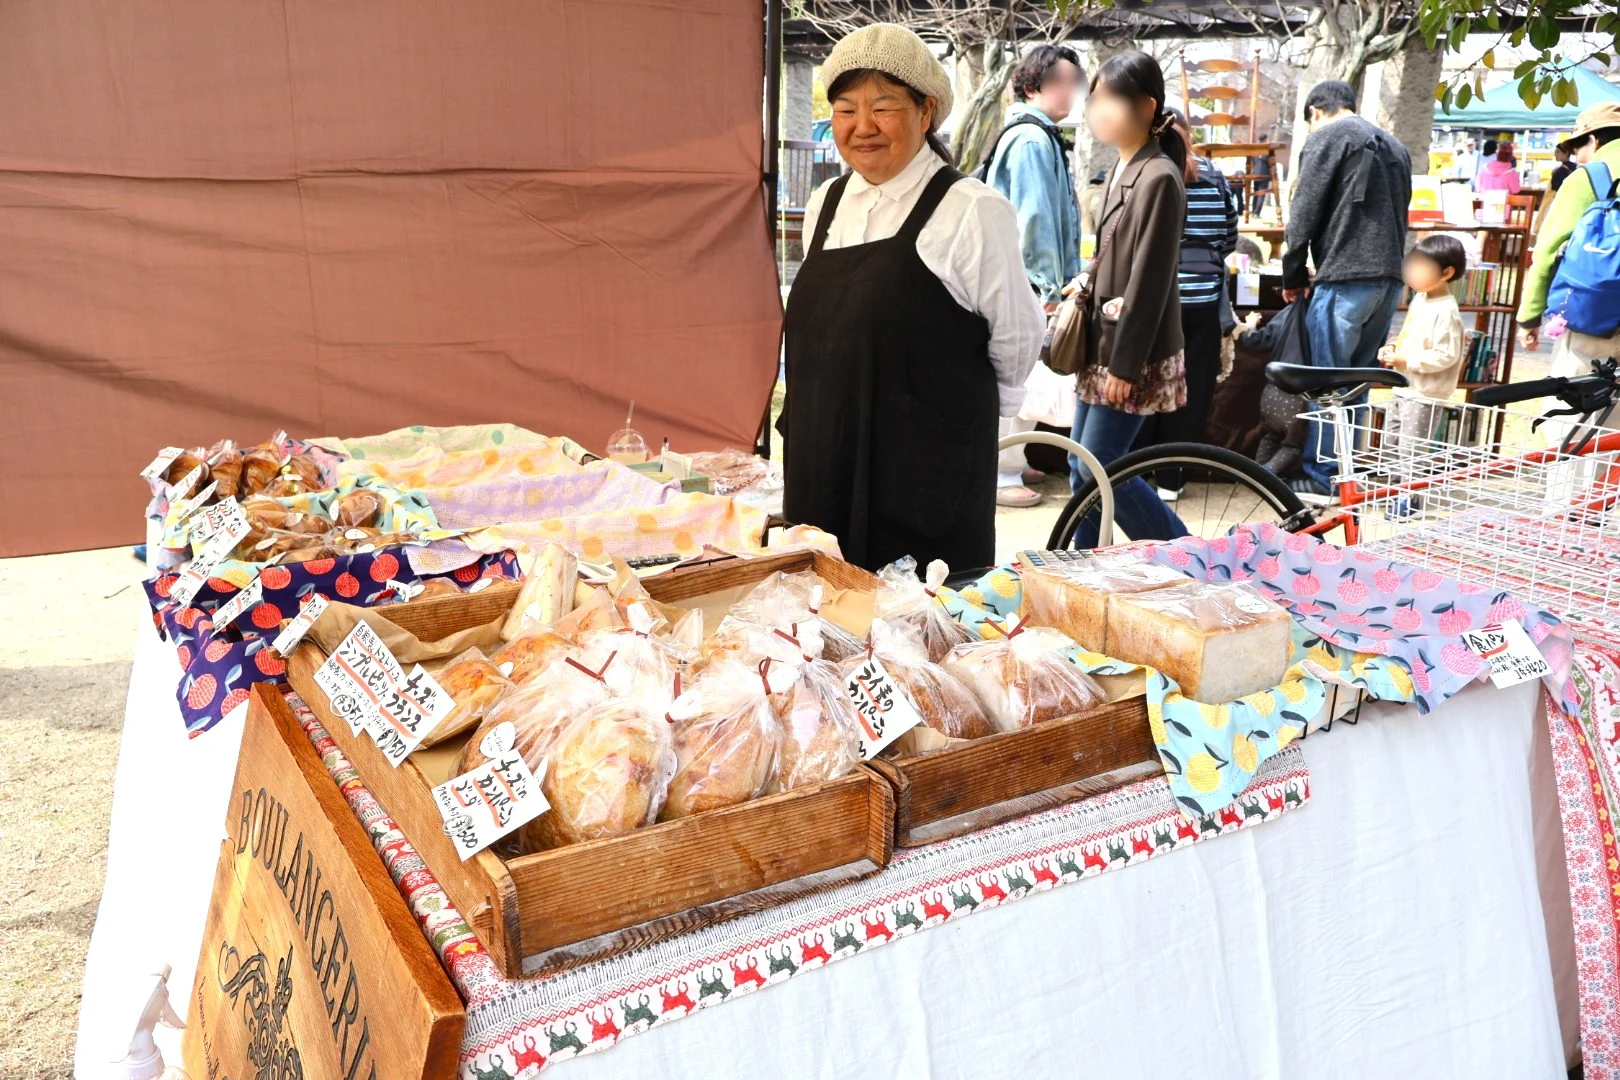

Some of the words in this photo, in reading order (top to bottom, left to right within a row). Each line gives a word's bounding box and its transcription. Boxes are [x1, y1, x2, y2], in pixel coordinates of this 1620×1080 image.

[1469, 633, 1505, 654] 食パン
[385, 693, 422, 732] フランス
[848, 681, 885, 739] カンパーニュ
[858, 662, 894, 713] ライ麦の
[454, 780, 482, 807] ゴーダ
[477, 774, 513, 828] カンパーニュ
[236, 787, 376, 1080] BOULANGERI
